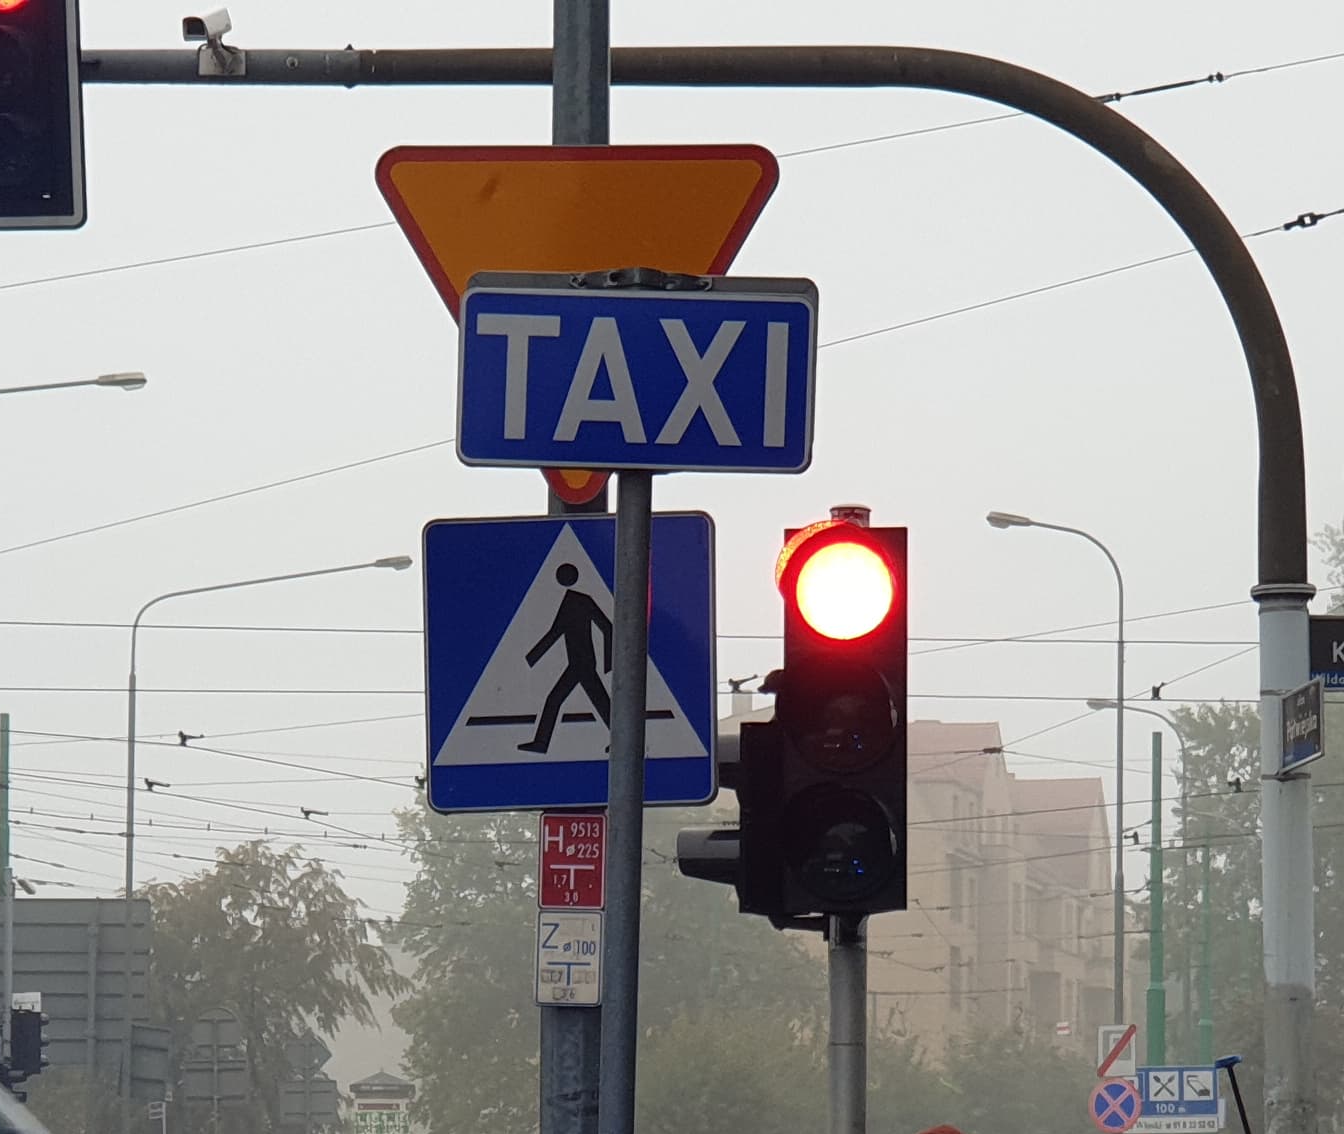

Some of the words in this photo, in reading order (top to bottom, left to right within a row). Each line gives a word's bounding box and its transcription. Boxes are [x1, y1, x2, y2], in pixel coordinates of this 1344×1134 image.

[476, 313, 790, 448] TAXI
[545, 824, 564, 854] H
[571, 822, 600, 838] 9513
[577, 843, 600, 859] 225
[542, 922, 560, 949] Z
[576, 940, 596, 956] 100
[1155, 1103, 1176, 1114] 100
